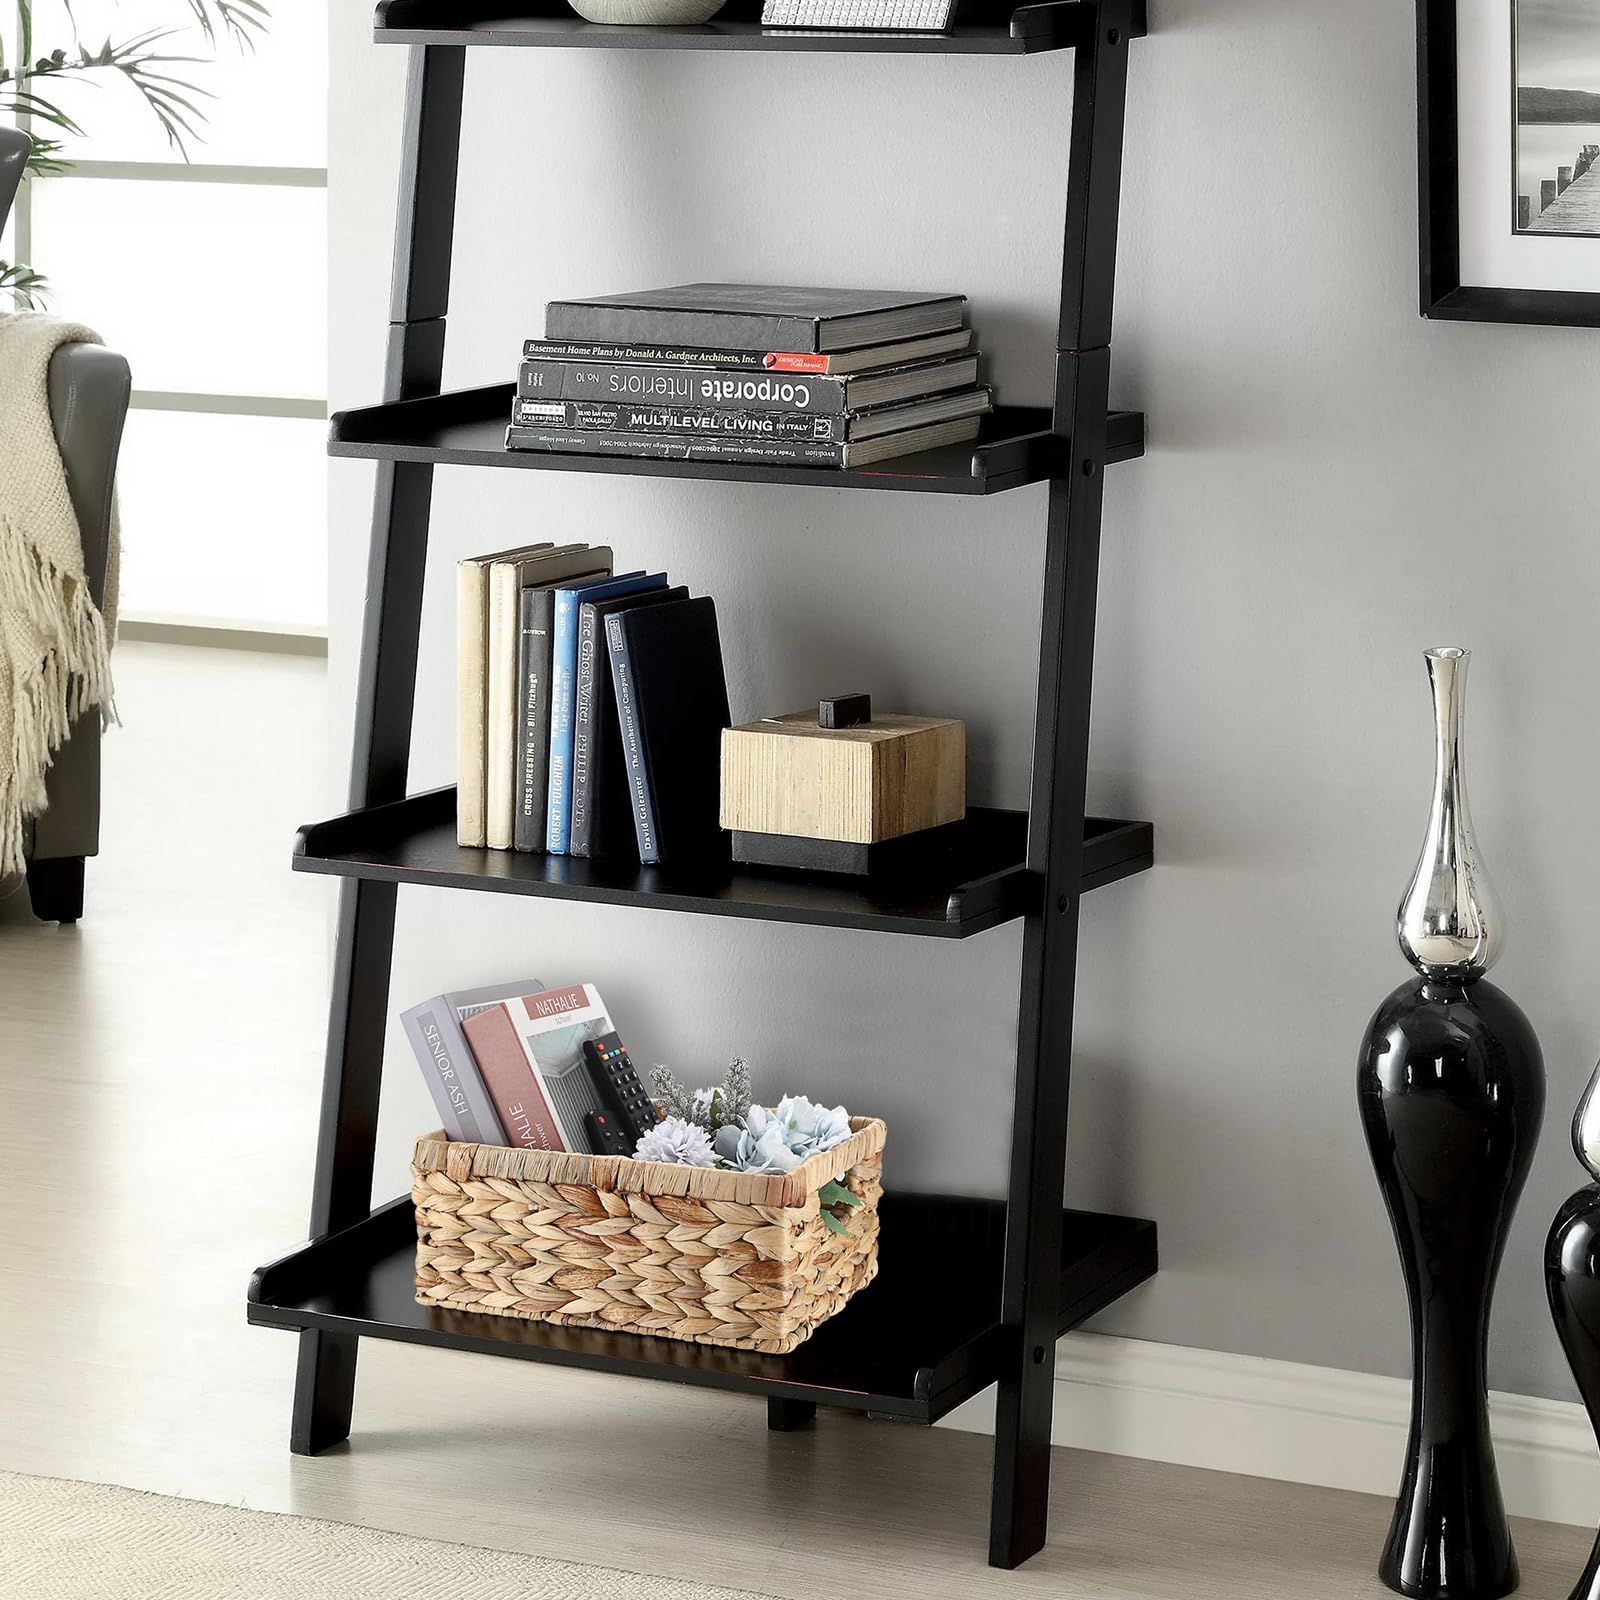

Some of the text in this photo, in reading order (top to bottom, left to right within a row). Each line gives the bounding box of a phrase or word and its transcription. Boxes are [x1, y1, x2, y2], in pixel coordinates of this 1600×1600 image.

[528, 344, 757, 364] Basement Home Plans by Donald A. Gardner Architects, Inc.
[609, 374, 810, 408] Corporate Interiors
[631, 414, 809, 432] MULTILEVEL LIVING IN ITALY
[744, 446, 764, 455] Design
[764, 448, 777, 456] Fair
[582, 610, 594, 636] The
[581, 640, 594, 679] Ghost
[618, 662, 631, 704] Computing
[578, 683, 593, 724] Writer
[524, 673, 538, 816] CROSS DRESSING Bill Fitzhugh
[627, 715, 638, 752] Aesthetics
[577, 734, 587, 783] PHILIP
[631, 754, 640, 769] The
[551, 755, 564, 848] ROBERT FULGHUM
[636, 776, 648, 820] Gelernter
[643, 823, 652, 850] David
[535, 993, 581, 1017] NATHALIE
[424, 1024, 468, 1115] SENIOR ASH
